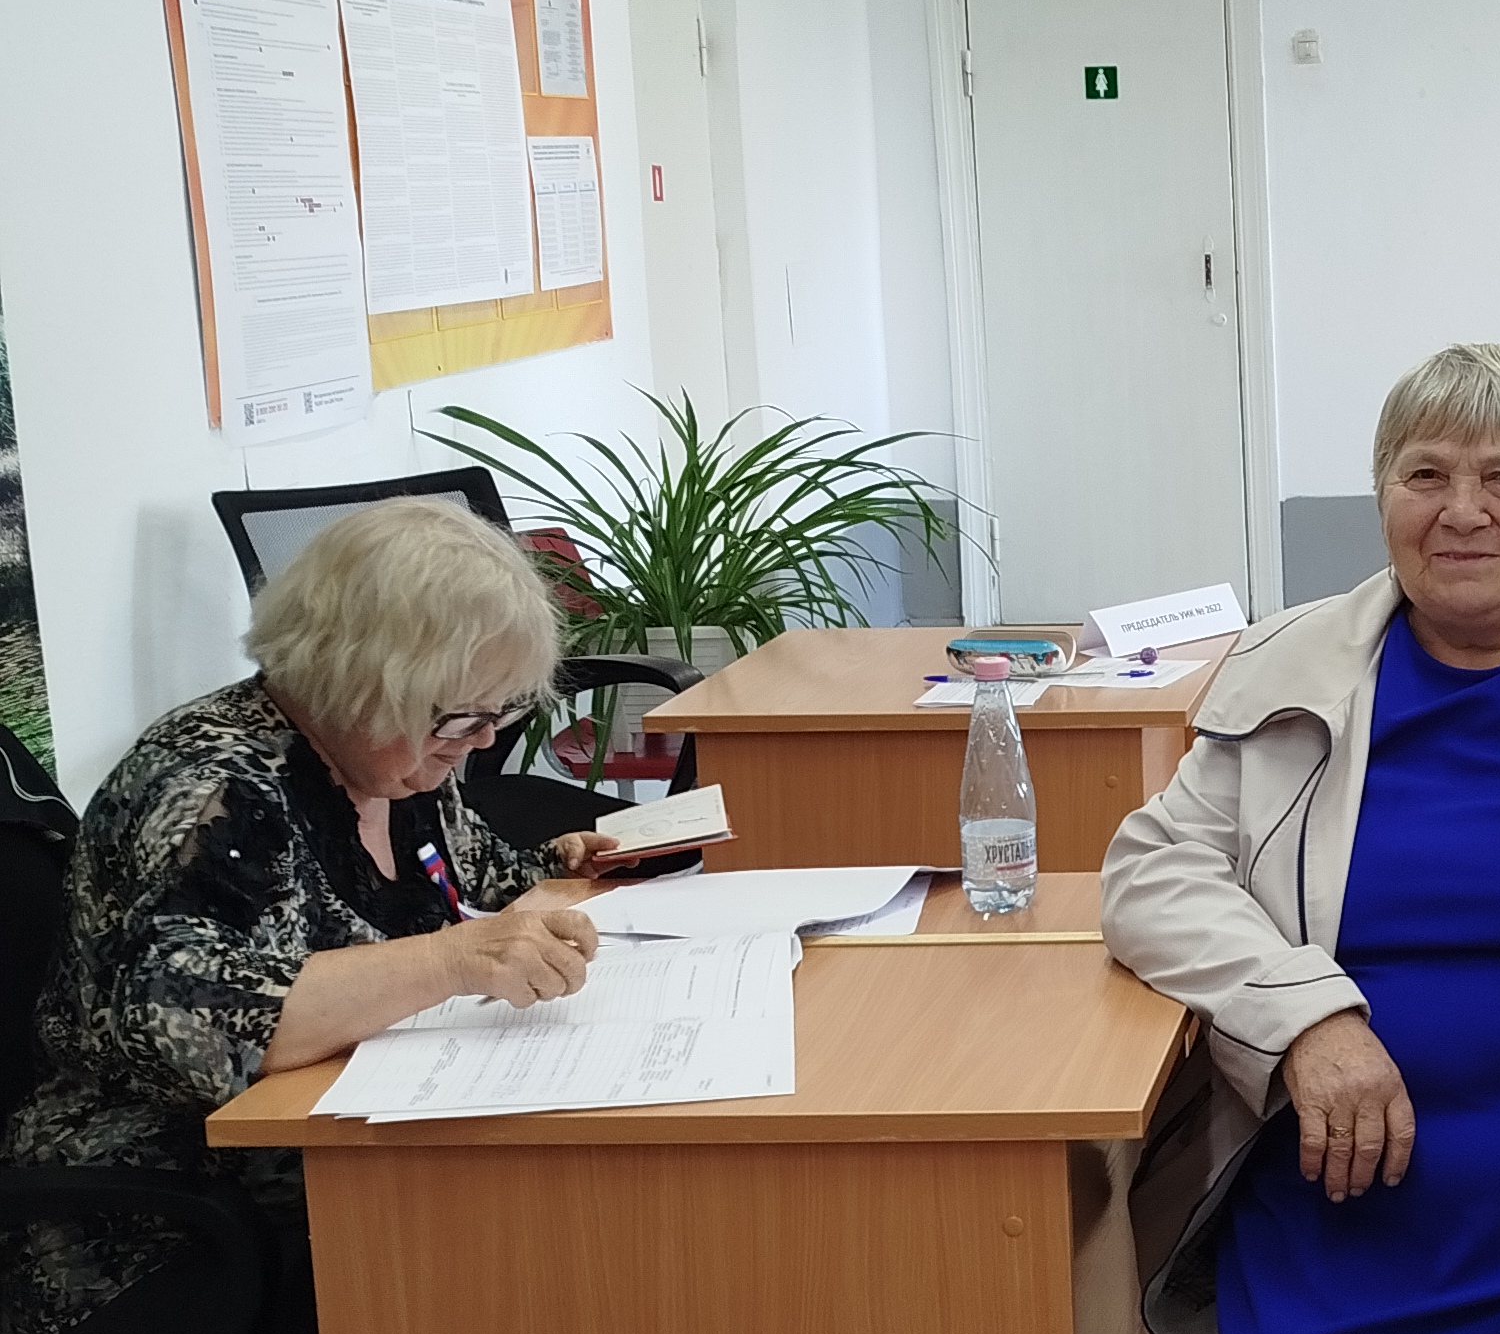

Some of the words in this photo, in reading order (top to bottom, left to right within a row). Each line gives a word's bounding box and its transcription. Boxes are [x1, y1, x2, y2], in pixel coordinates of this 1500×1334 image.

[1120, 613, 1180, 633] ПРЕДСЕДАТЕЛЬ
[1179, 608, 1196, 620] УИК
[1195, 607, 1205, 616] №
